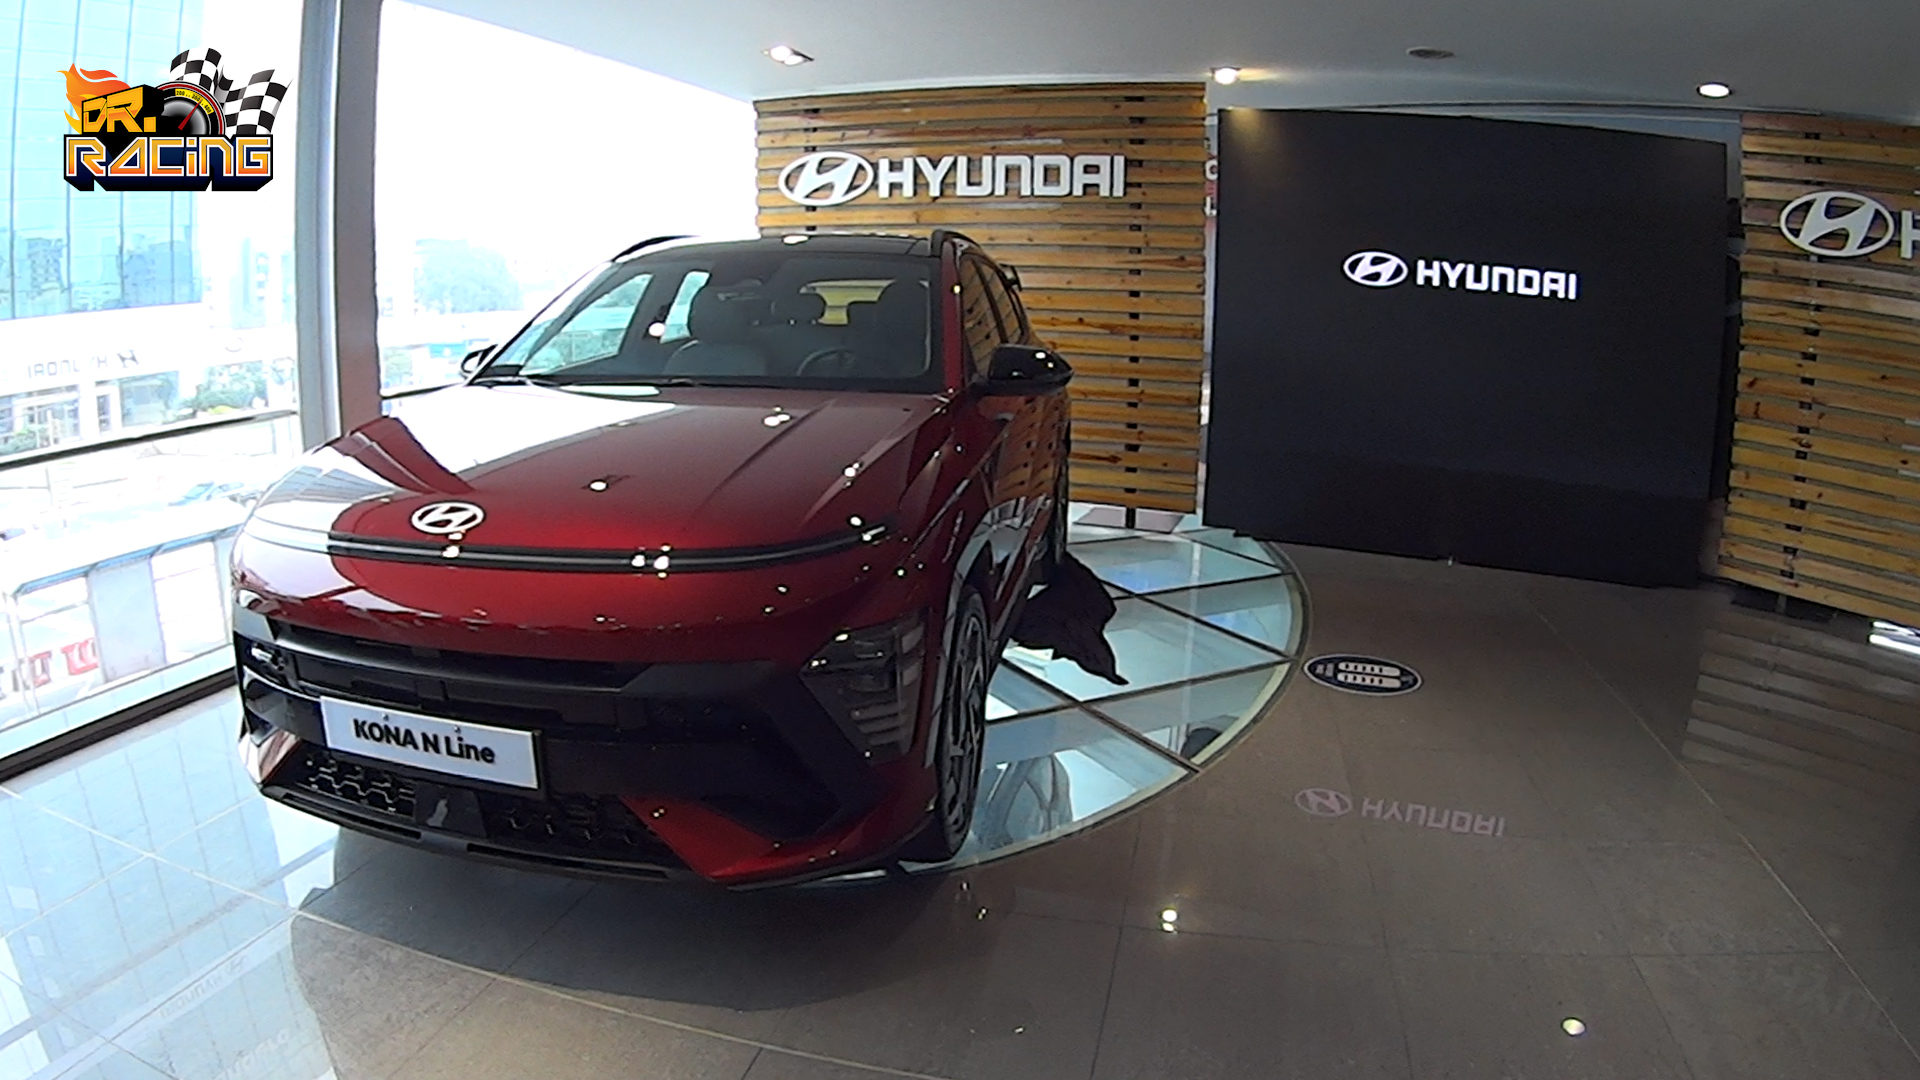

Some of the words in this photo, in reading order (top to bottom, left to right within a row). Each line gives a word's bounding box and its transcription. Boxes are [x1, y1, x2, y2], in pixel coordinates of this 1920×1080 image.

[877, 153, 1126, 199] HYUNDAI
[1416, 259, 1578, 301] HYUNDAI
[352, 718, 419, 751] KONA
[421, 731, 442, 755] N
[444, 735, 496, 764] Line
